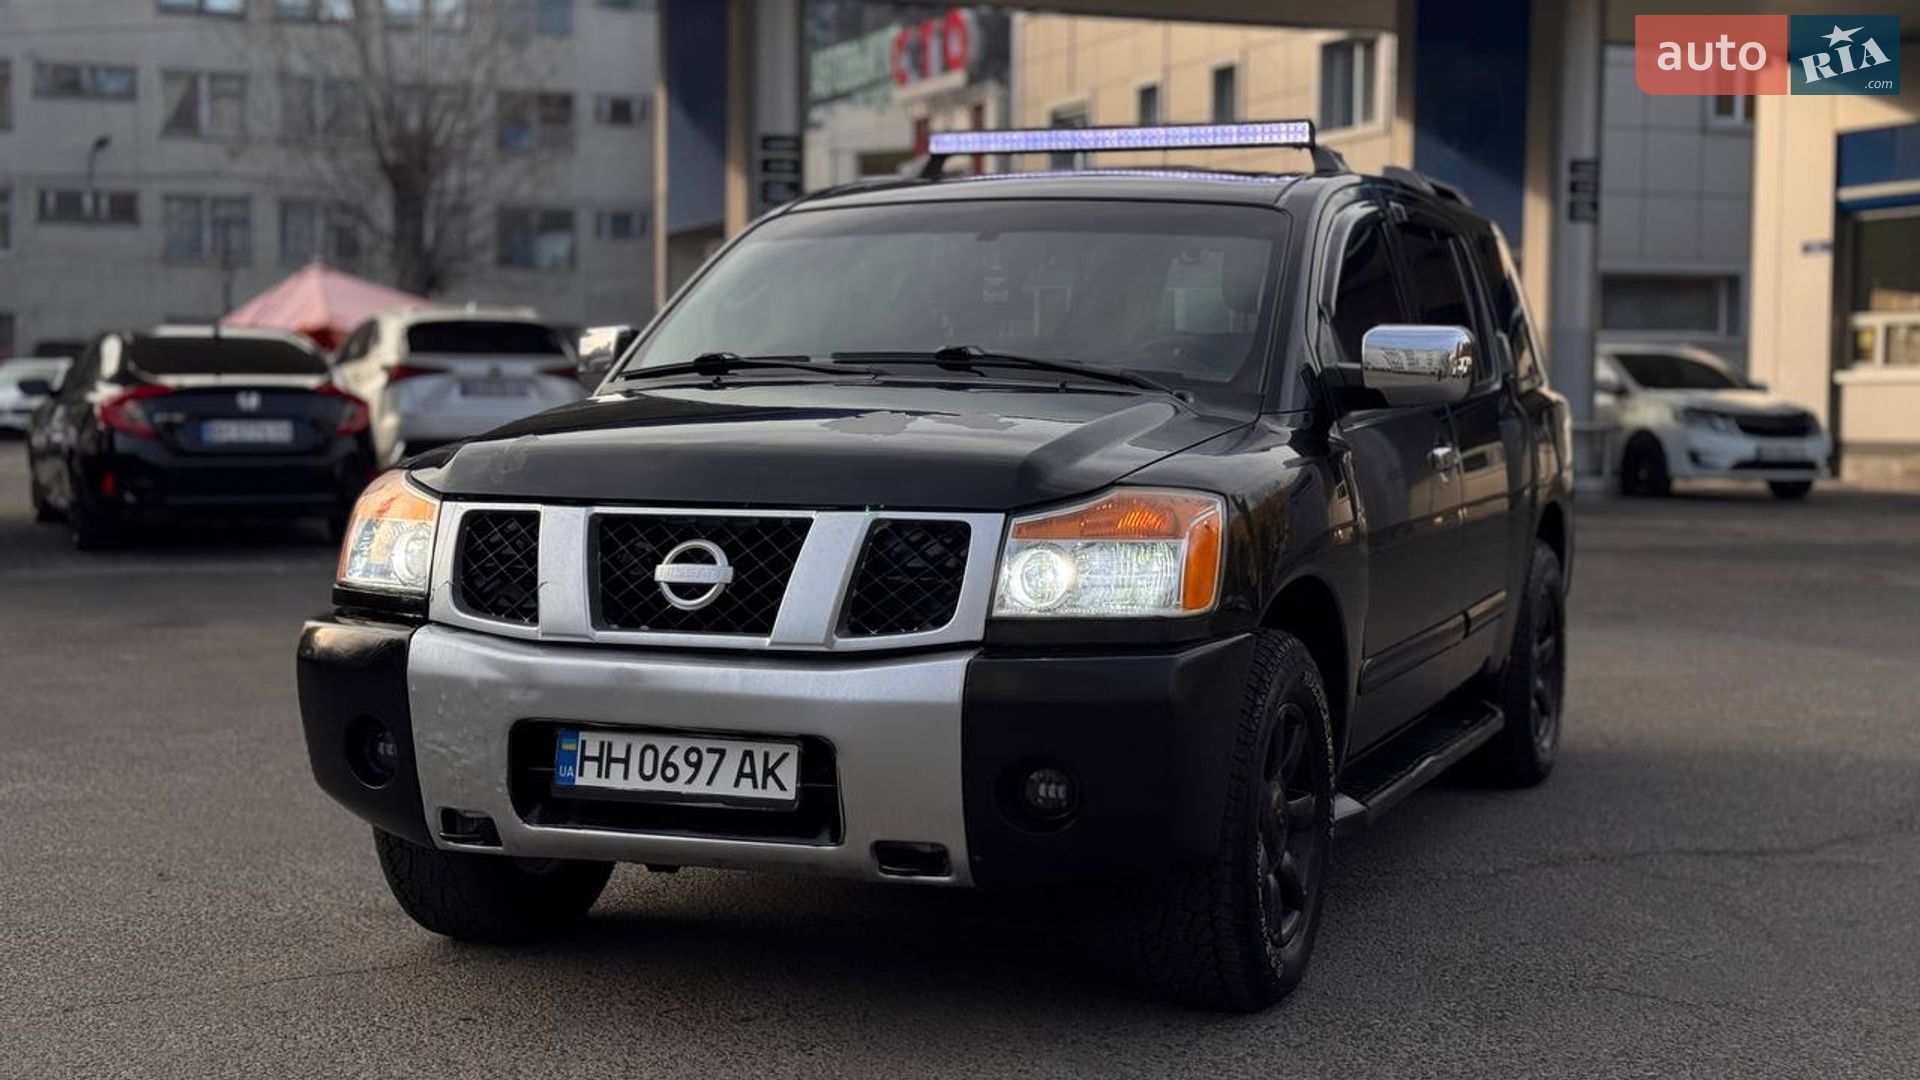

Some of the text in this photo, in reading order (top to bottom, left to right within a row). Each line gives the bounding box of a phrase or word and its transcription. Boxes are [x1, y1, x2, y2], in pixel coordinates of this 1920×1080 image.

[559, 765, 575, 778] UA
[578, 739, 790, 792] HH 0697 AK
